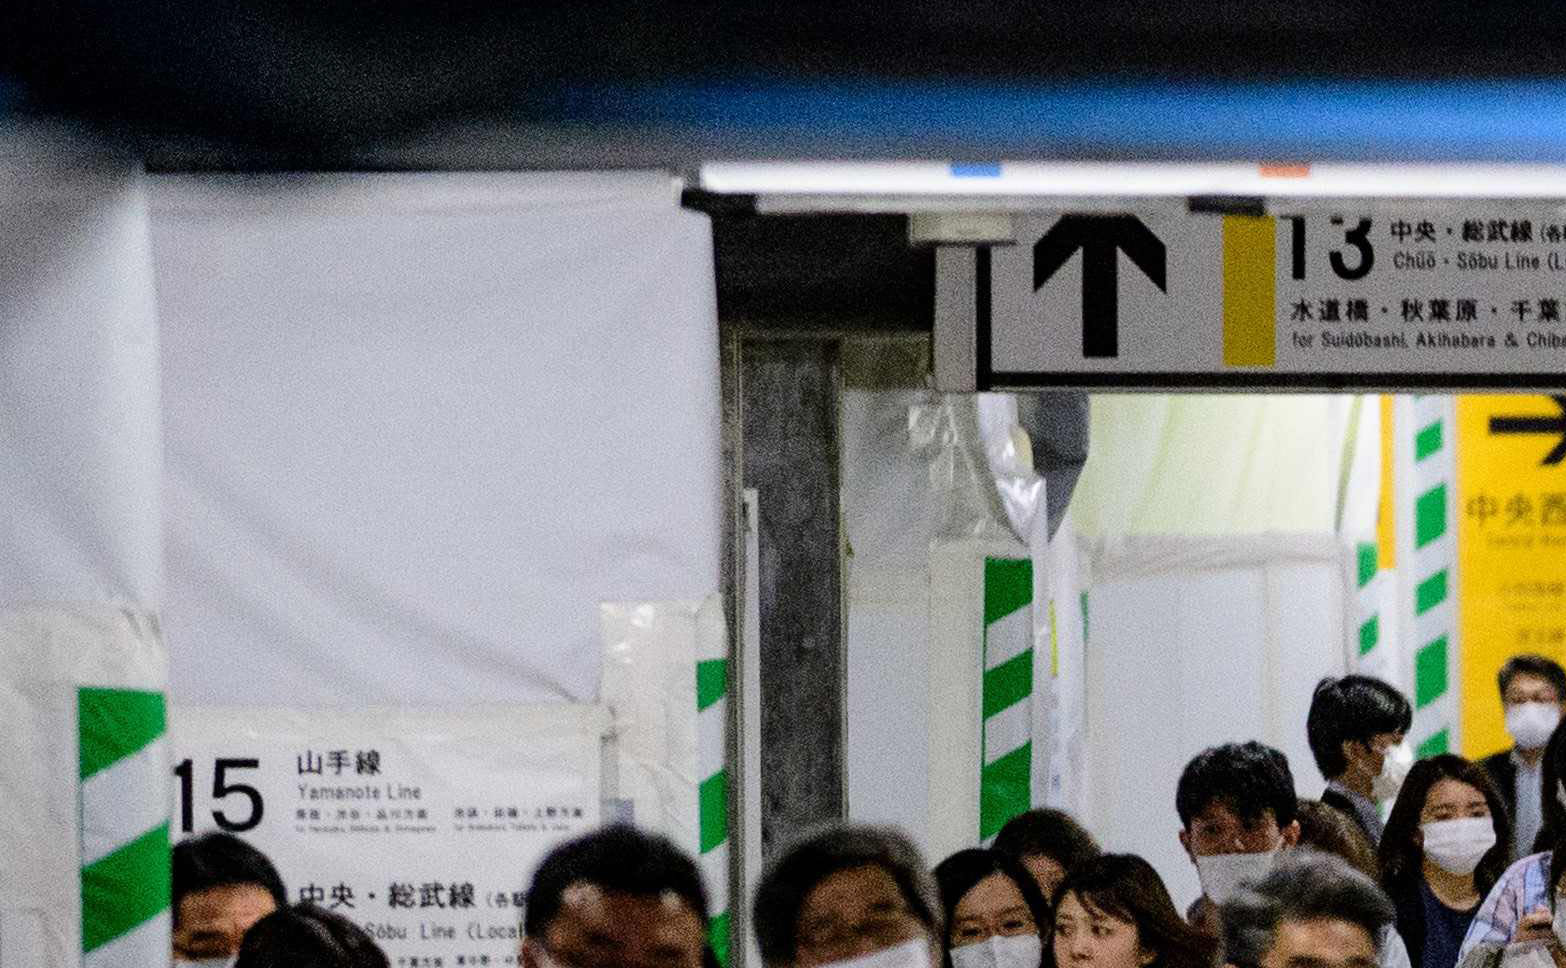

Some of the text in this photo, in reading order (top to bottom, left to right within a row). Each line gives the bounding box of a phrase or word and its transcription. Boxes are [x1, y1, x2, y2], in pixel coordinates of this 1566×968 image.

[1283, 214, 1375, 281] 13
[1505, 252, 1539, 270] Line
[1293, 332, 1313, 347] for
[1416, 331, 1495, 347] Akihabara
[1504, 333, 1519, 347] &
[298, 750, 381, 775] 山手線
[174, 758, 264, 833] 15
[299, 784, 421, 800] Yamanote Line
[420, 922, 455, 939] Line
